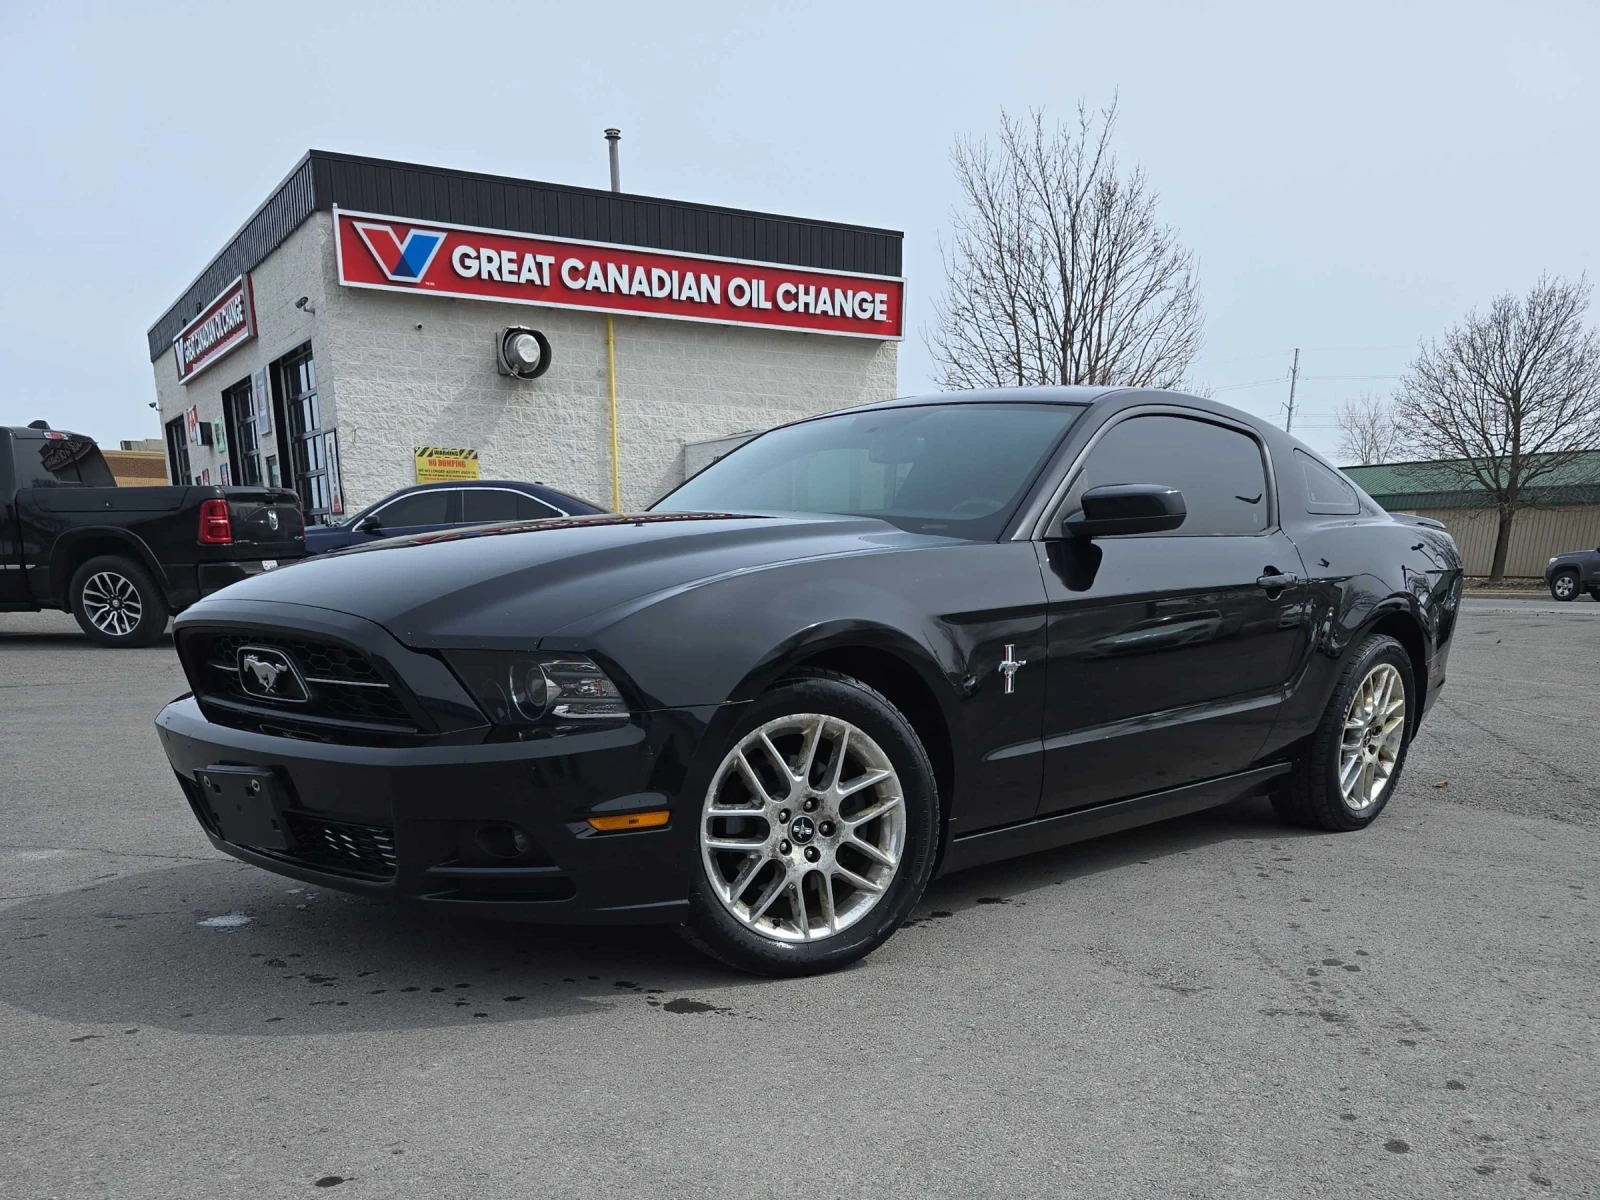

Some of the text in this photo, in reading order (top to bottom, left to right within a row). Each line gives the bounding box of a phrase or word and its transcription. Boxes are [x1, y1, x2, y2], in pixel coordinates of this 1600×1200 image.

[452, 245, 889, 322] GREAT CANADIAN OIL CHANGE
[195, 317, 218, 356] CANADIAN
[223, 294, 244, 333] CHANGE
[428, 459, 466, 468] NO DUMPING
